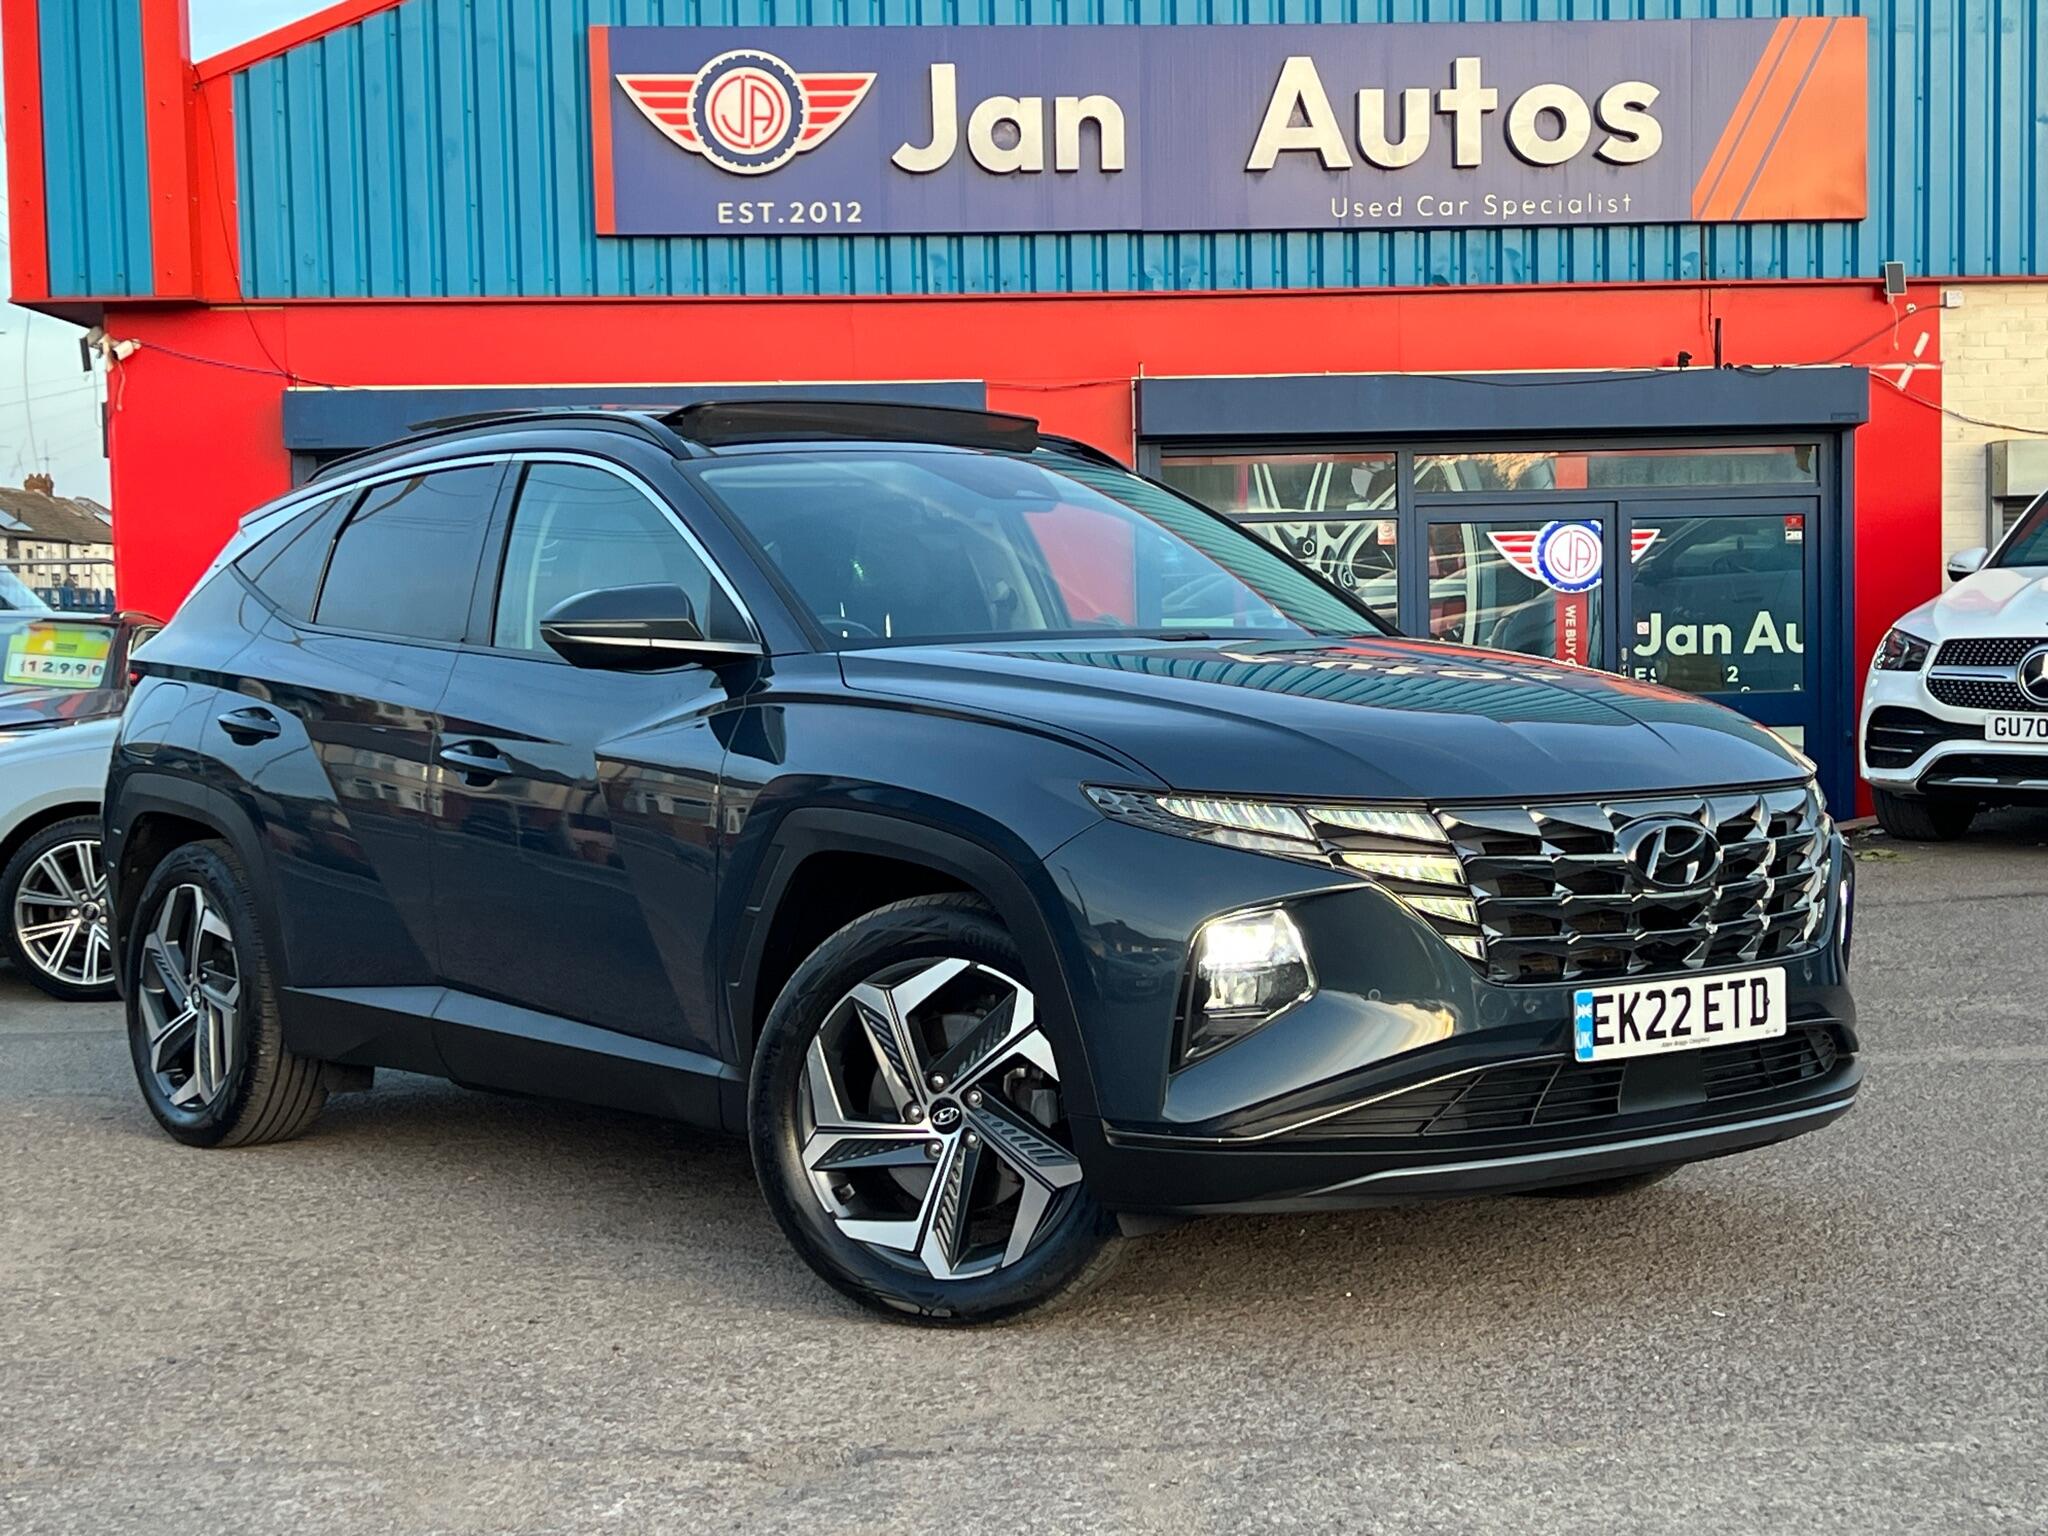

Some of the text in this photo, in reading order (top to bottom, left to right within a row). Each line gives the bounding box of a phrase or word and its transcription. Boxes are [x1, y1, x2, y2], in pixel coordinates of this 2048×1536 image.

[890, 55, 1663, 173] Jan Autos
[717, 201, 863, 224] EST.2012
[1331, 192, 1633, 219] Used Car Specialist
[1565, 604, 1577, 628] WE
[1565, 629, 1577, 656] BUY
[1633, 612, 1732, 656] Jan
[1994, 716, 2048, 738] GU70
[1593, 977, 1769, 1047] EK22 ETD
